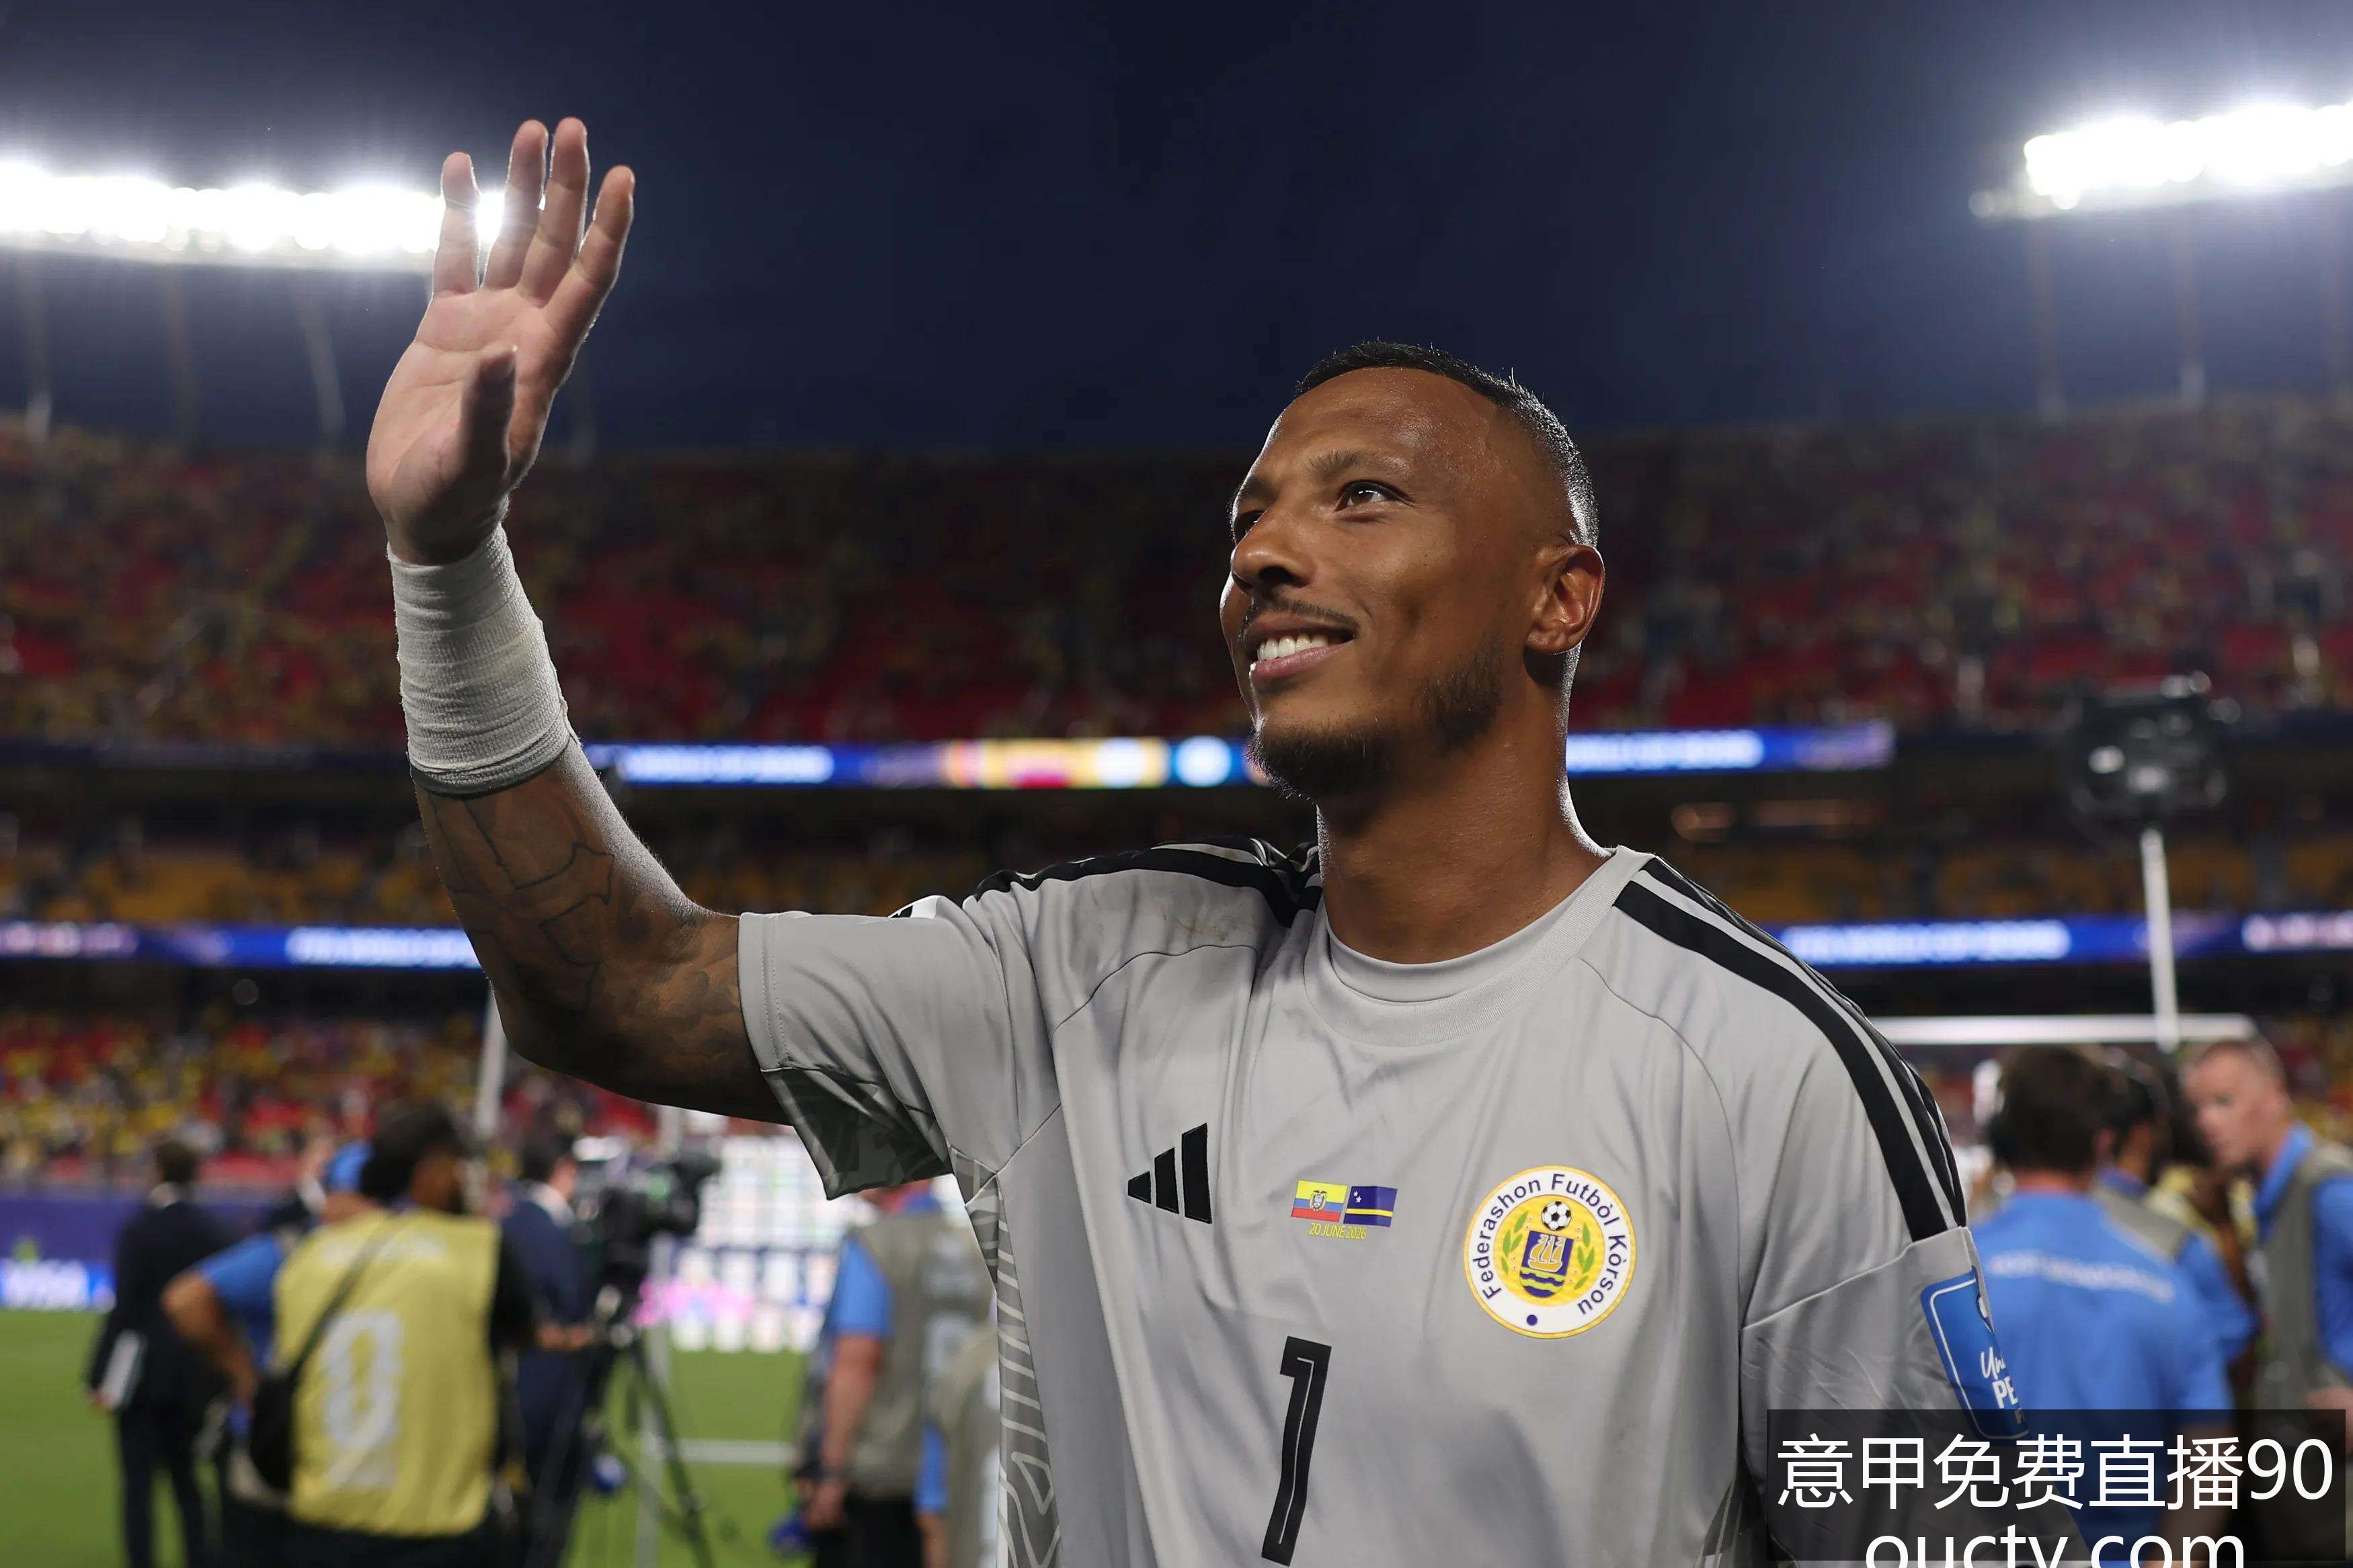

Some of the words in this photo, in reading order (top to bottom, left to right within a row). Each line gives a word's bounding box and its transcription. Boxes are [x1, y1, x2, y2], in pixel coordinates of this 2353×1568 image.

[1308, 1223, 1322, 1235] 20
[1320, 1223, 1346, 1238] JUNE
[1345, 1226, 1367, 1239] 2026
[1473, 1179, 1541, 1300] Federashon
[1551, 1173, 1620, 1227] Futbòl
[1577, 1234, 1628, 1315] Kòrsou
[1261, 1335, 1332, 1567] 1
